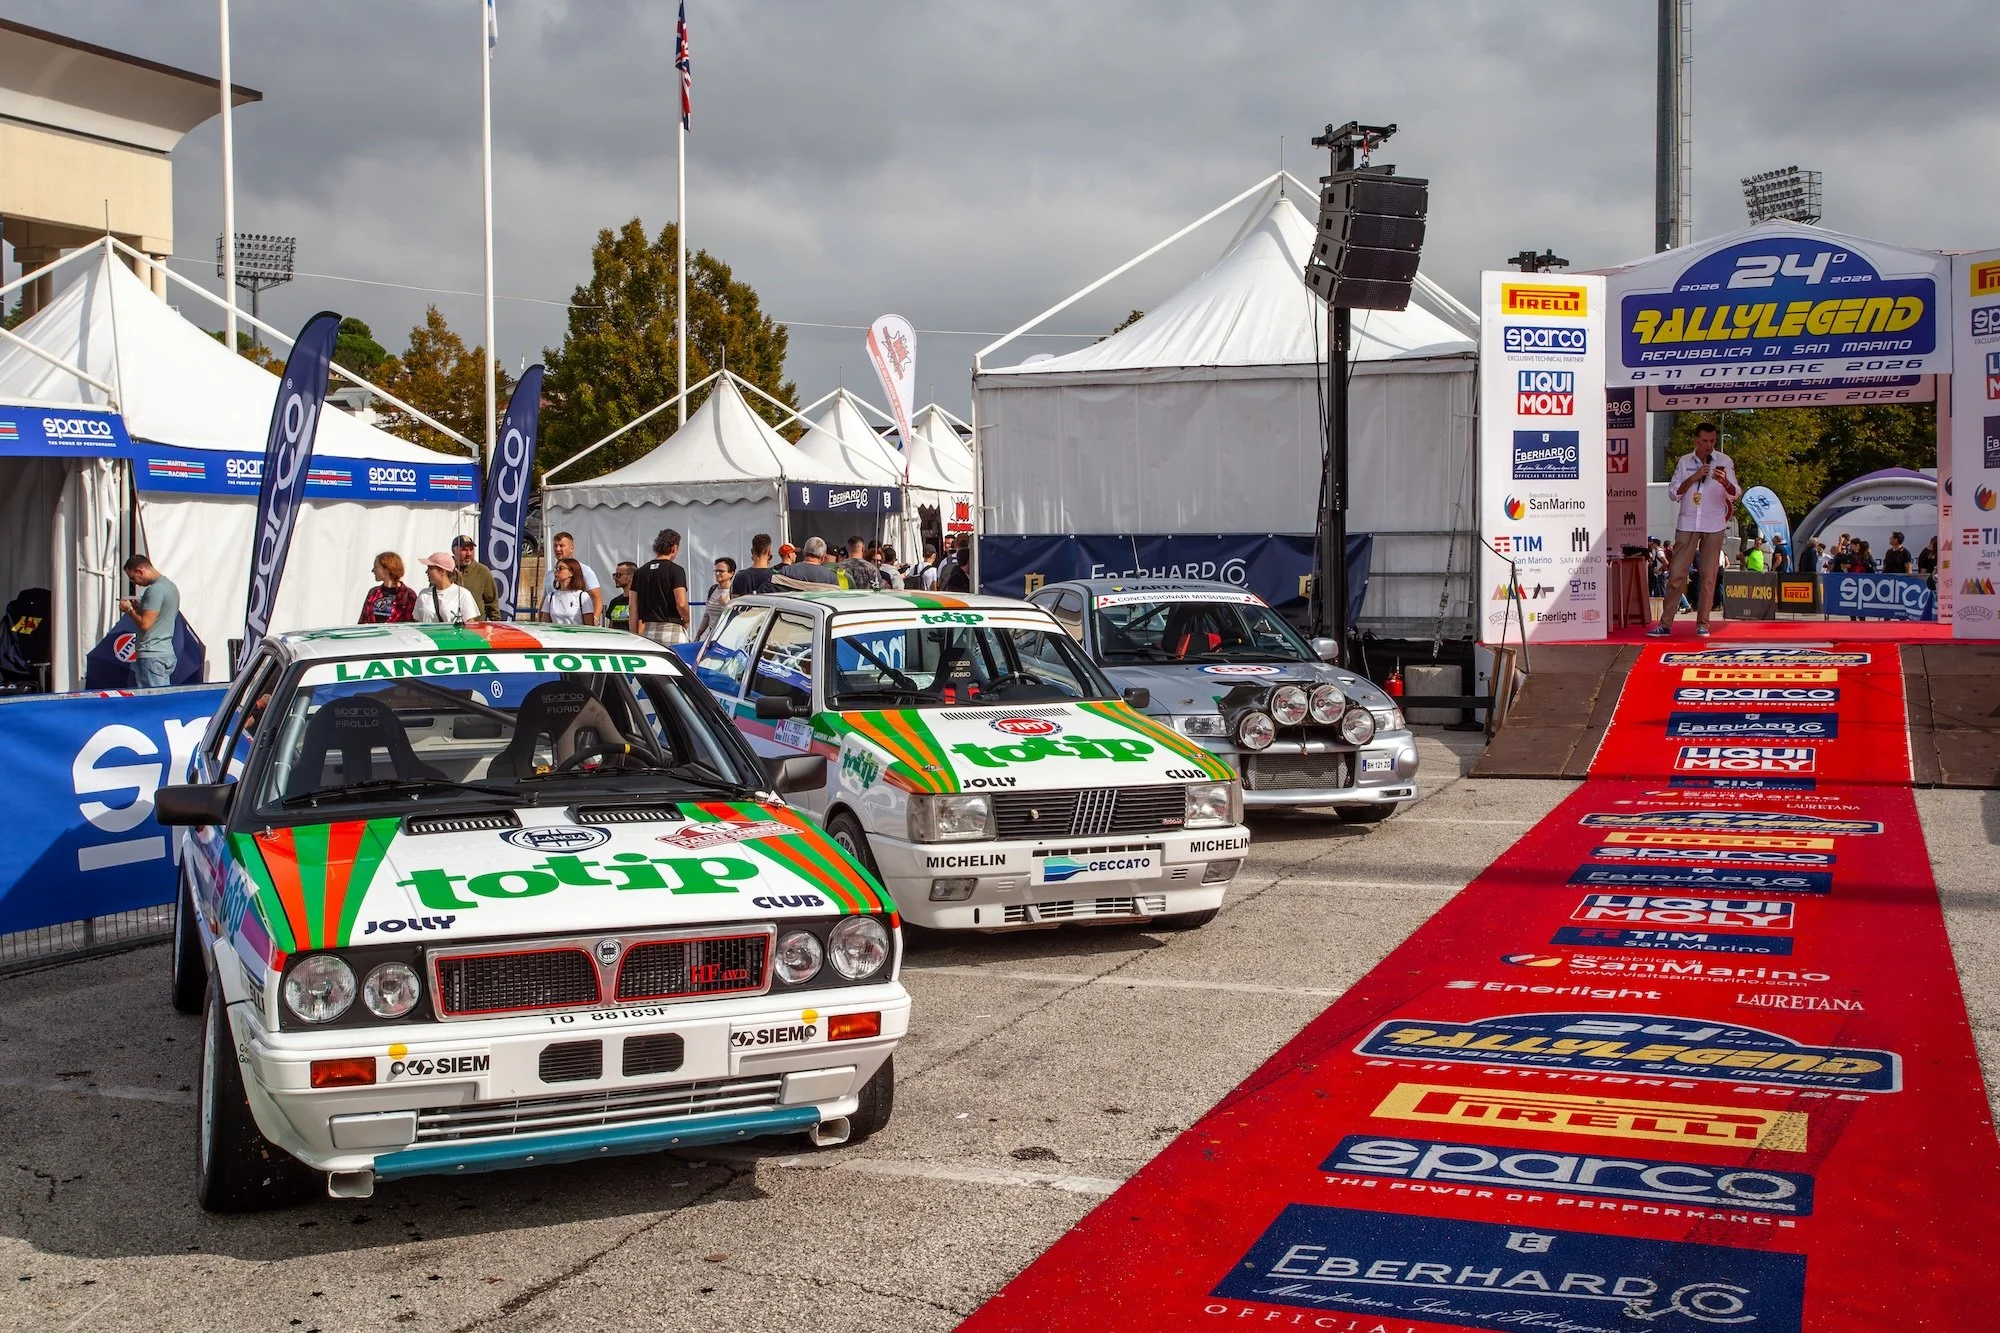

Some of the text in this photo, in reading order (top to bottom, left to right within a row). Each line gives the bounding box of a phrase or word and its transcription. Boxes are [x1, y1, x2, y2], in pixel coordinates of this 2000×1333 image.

[1830, 274, 1873, 284] 2026
[1509, 289, 1580, 311] PIRELLI
[1632, 296, 1924, 345] RALLYLEGEND
[1506, 329, 1585, 352] sparco
[1640, 339, 1913, 361] REPUBBLICA DI SAN MARINO
[1630, 359, 1923, 380] 8-11 OTTOBRE 2026
[1520, 371, 1572, 393] LIQUI
[1519, 394, 1573, 414] MOLY
[1666, 389, 1911, 406] 8-11 OTTOBRE 2026
[43, 418, 111, 439] sparco
[1515, 447, 1565, 462] EBERHARD
[167, 460, 188, 468] MARTINI
[168, 471, 189, 479] RACING
[368, 466, 416, 485] sparco
[828, 488, 861, 507] EBERHARD
[1529, 498, 1586, 510] SanMarino
[1863, 494, 1937, 503] HYUNDAI MOTORSPOR
[1513, 536, 1542, 552] TIM
[1982, 527, 2000, 545] TI
[1514, 556, 1553, 564] San Marino
[1560, 555, 1602, 564] SAN MARINO
[1567, 567, 1593, 575] OUTLET
[1582, 581, 1597, 591] TIS
[1784, 586, 1810, 599] PIRELLI
[1839, 577, 1929, 611] sparco
[1117, 594, 1242, 602] CONCESSIONARI MITSUBISHI
[921, 611, 984, 625] totip
[1537, 611, 1577, 623] Enerlight
[336, 654, 647, 682] LANCIA TOTIP
[1696, 669, 1823, 679] PIRELLI
[1679, 687, 1835, 702] sparco
[547, 705, 581, 714] FIORIO
[335, 719, 379, 728] PIROLLO
[1000, 722, 1048, 731] FIAT
[1678, 721, 1796, 733] EBERHARD
[949, 735, 1155, 768] totip
[1686, 747, 1808, 760] LIQUI
[843, 747, 880, 790] totip
[1683, 759, 1810, 771] MOLY
[1165, 768, 1208, 779] CLUB
[963, 776, 1016, 788] JOLLY
[1713, 779, 1764, 788] TIM
[1786, 803, 1861, 811] LAURETANA
[534, 832, 587, 841] LANCIA
[1625, 834, 1813, 847] PIRELLI
[1190, 837, 1250, 853] MICHELIN
[926, 853, 1006, 869] MICHELIN
[1595, 847, 1829, 862] sparco
[1088, 857, 1150, 873] CECCATO
[396, 852, 760, 911] totip
[1586, 871, 1767, 884] EBERHARD
[751, 893, 825, 910] CLUB
[1592, 894, 1782, 914] LIQUI
[1583, 906, 1787, 928] MOLY
[364, 915, 456, 936] JOLLY
[1629, 930, 1711, 943] TIM
[1623, 940, 1771, 954] San Marino
[1573, 953, 1703, 966] Repubblica di
[690, 963, 749, 985] HF 4WD
[1568, 957, 1832, 983] SanMarino
[1570, 969, 1809, 989] www.visitsanmarino.com
[1483, 981, 1662, 1001] Enerlight
[1736, 993, 1866, 1012] LAURETANA
[547, 1006, 669, 1025] TO 88189F
[1383, 1028, 1883, 1075] RALLYLEGEND
[436, 1054, 490, 1074] SIEM
[1377, 1044, 1861, 1085] REPUBBLICA DI SAN MARINO
[1364, 1060, 1452, 1072] 8-11
[1482, 1067, 1698, 1090] OTTOBRE
[1411, 1091, 1767, 1141] PIRELLI
[1346, 1139, 1797, 1200] sparco
[1324, 1175, 1796, 1229] THE POWER OF PERFORMANCE
[1270, 1244, 1659, 1298] EBERHARD
[1203, 1303, 1418, 1333] OFFICIA
